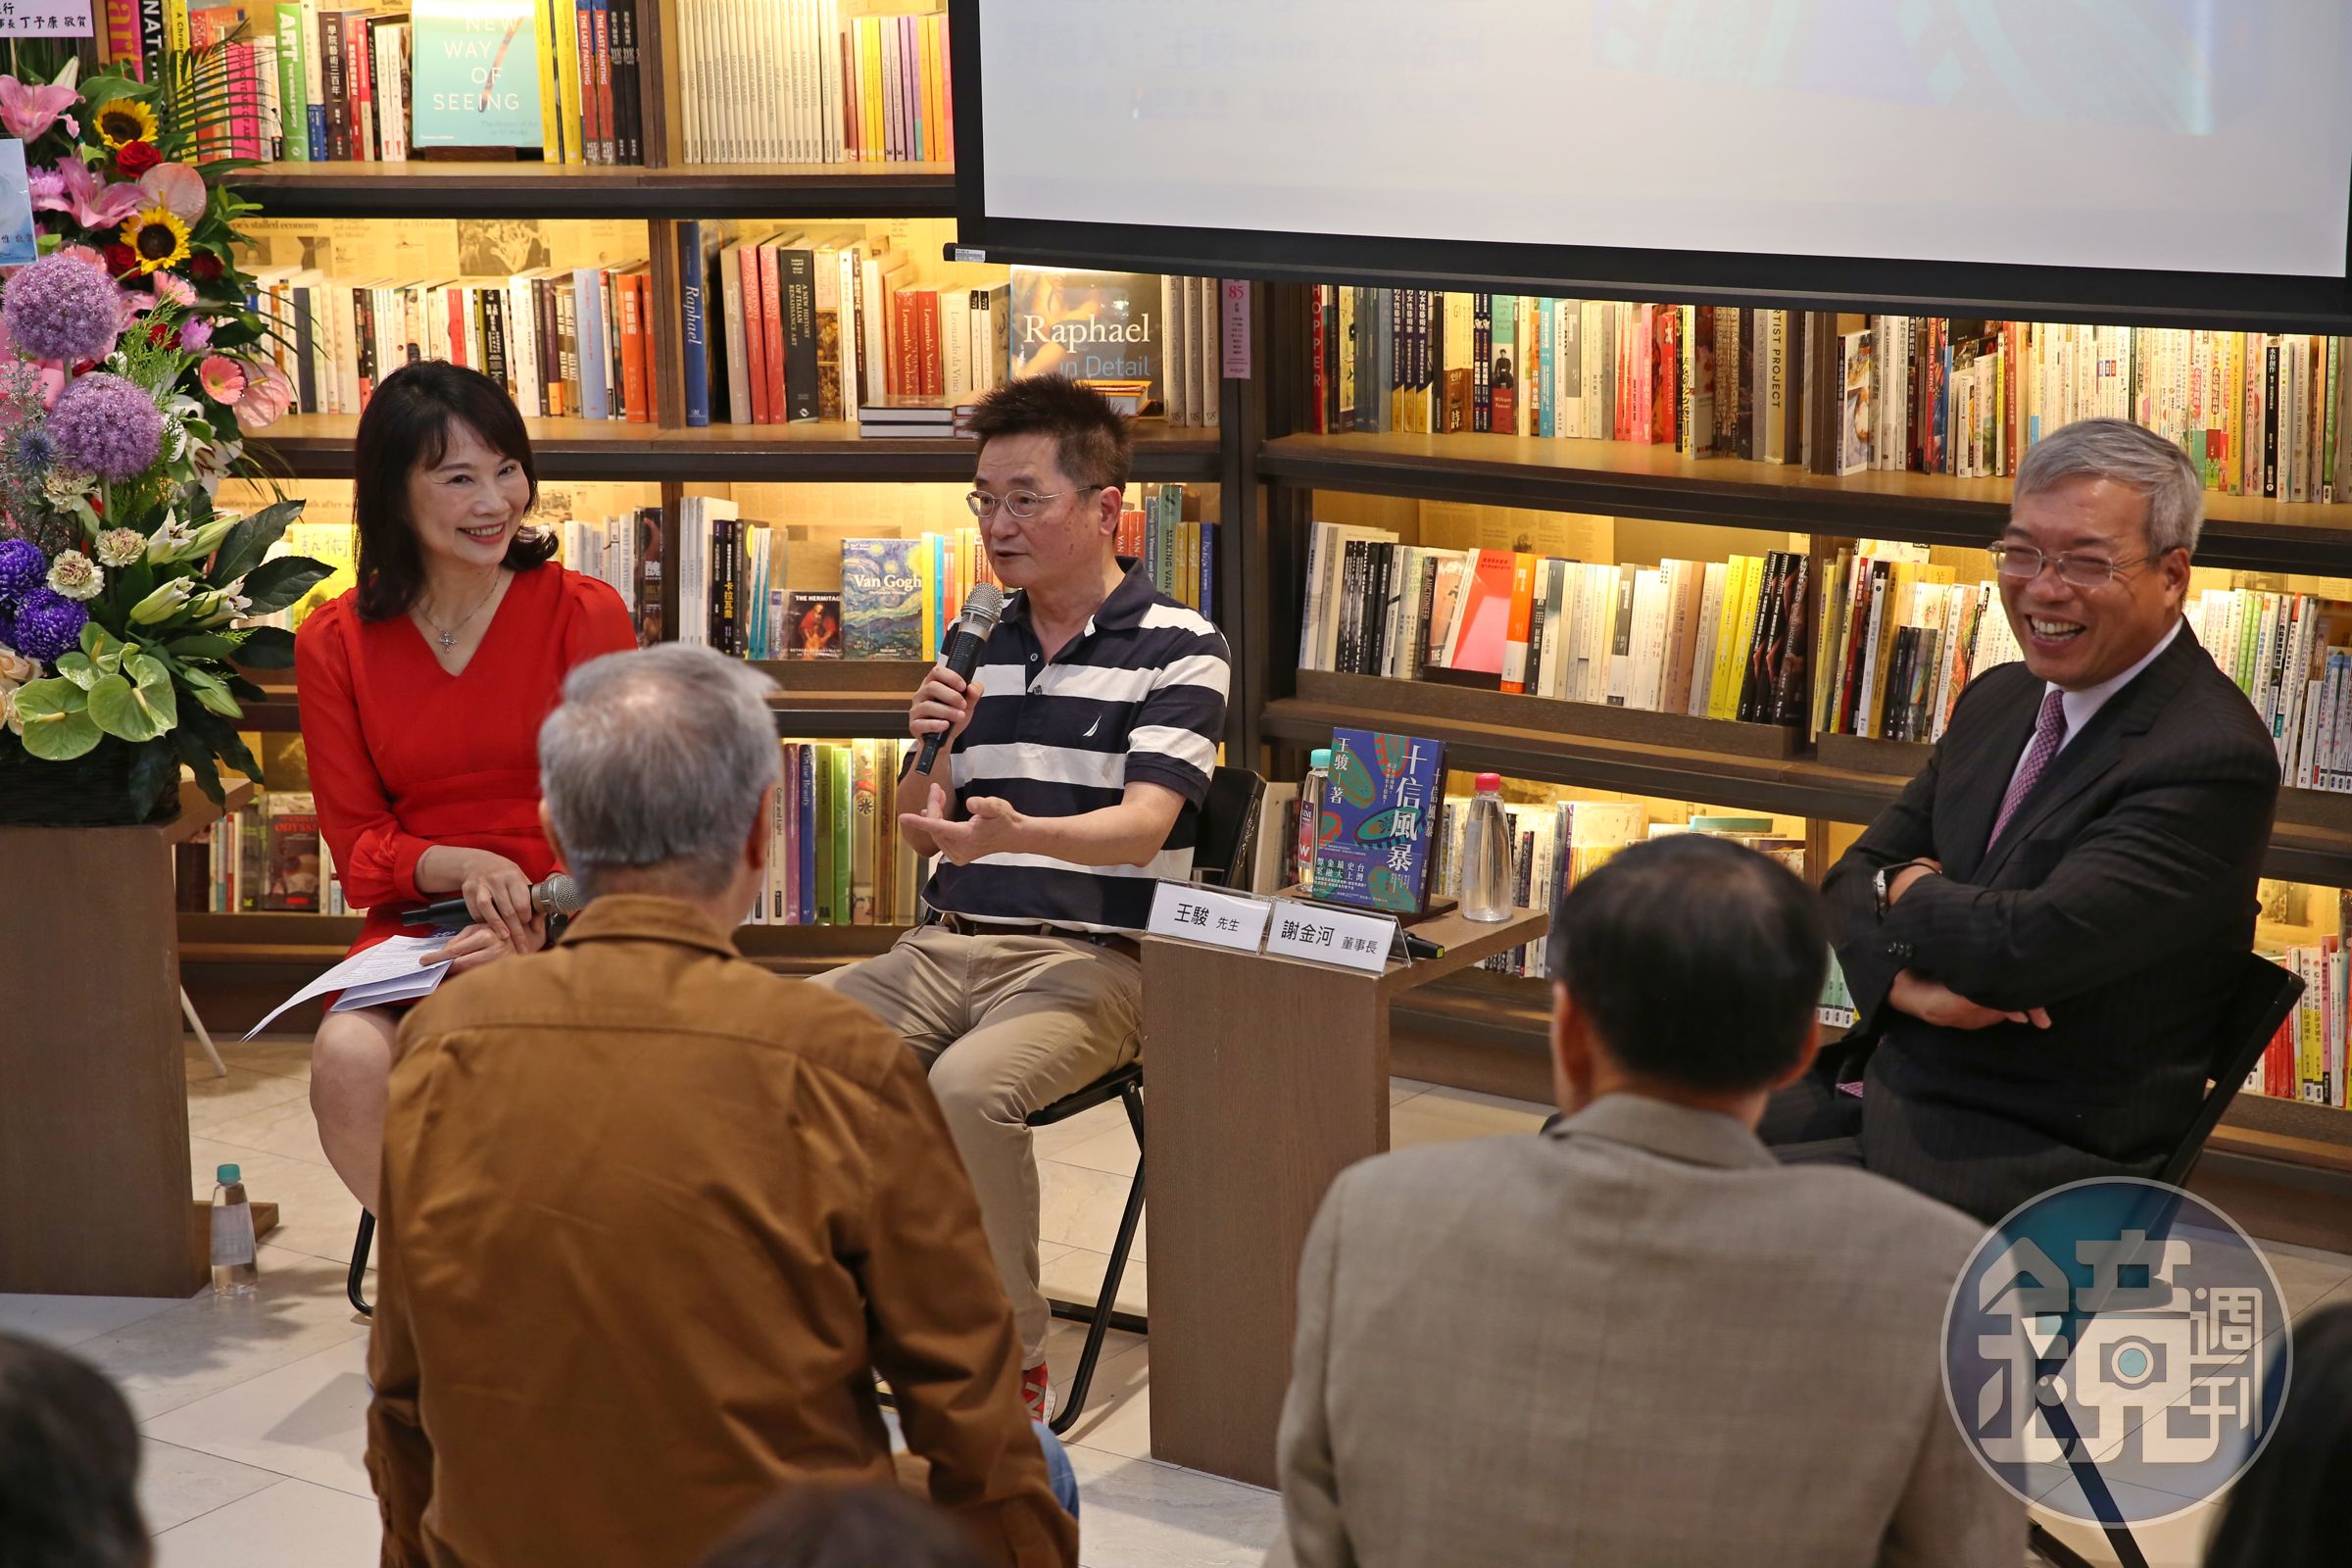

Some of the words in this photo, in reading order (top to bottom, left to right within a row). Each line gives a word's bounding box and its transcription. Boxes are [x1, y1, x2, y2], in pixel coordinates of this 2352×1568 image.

[0, 3, 14, 15] 行
[466, 18, 517, 31] NEW
[279, 13, 298, 62] ART
[443, 41, 491, 58] WAY
[471, 67, 502, 84] OF
[582, 49, 591, 85] PAINTING
[599, 49, 608, 85] PAINTING
[433, 94, 519, 110] SEEING
[1229, 285, 1244, 298] 85
[685, 285, 702, 345] Raphael
[903, 309, 911, 352] Leonardo's
[924, 309, 933, 352] Leonardo's
[951, 312, 961, 354] Leonardo
[1024, 314, 1151, 353] Raphael
[1312, 284, 1322, 387] HOPPER
[953, 358, 959, 367] da
[1060, 359, 1077, 376] in
[1086, 356, 1151, 376] Detail
[1772, 349, 1781, 408] PROJECT
[855, 575, 881, 588] Van
[884, 575, 921, 591] Gogh
[1422, 580, 1433, 619] AUCTIONEER
[802, 752, 810, 778] Divine
[802, 780, 810, 807] Beauty
[1388, 745, 1427, 871] 十信風暴
[1425, 768, 1442, 837] 十信風暴
[1326, 858, 1334, 877] 金融
[1347, 862, 1354, 880] 史上
[1174, 903, 1209, 927] 王駿
[1216, 916, 1240, 932] 先生
[1281, 920, 1336, 948] 謝金河
[1341, 936, 1379, 956] 董事長
